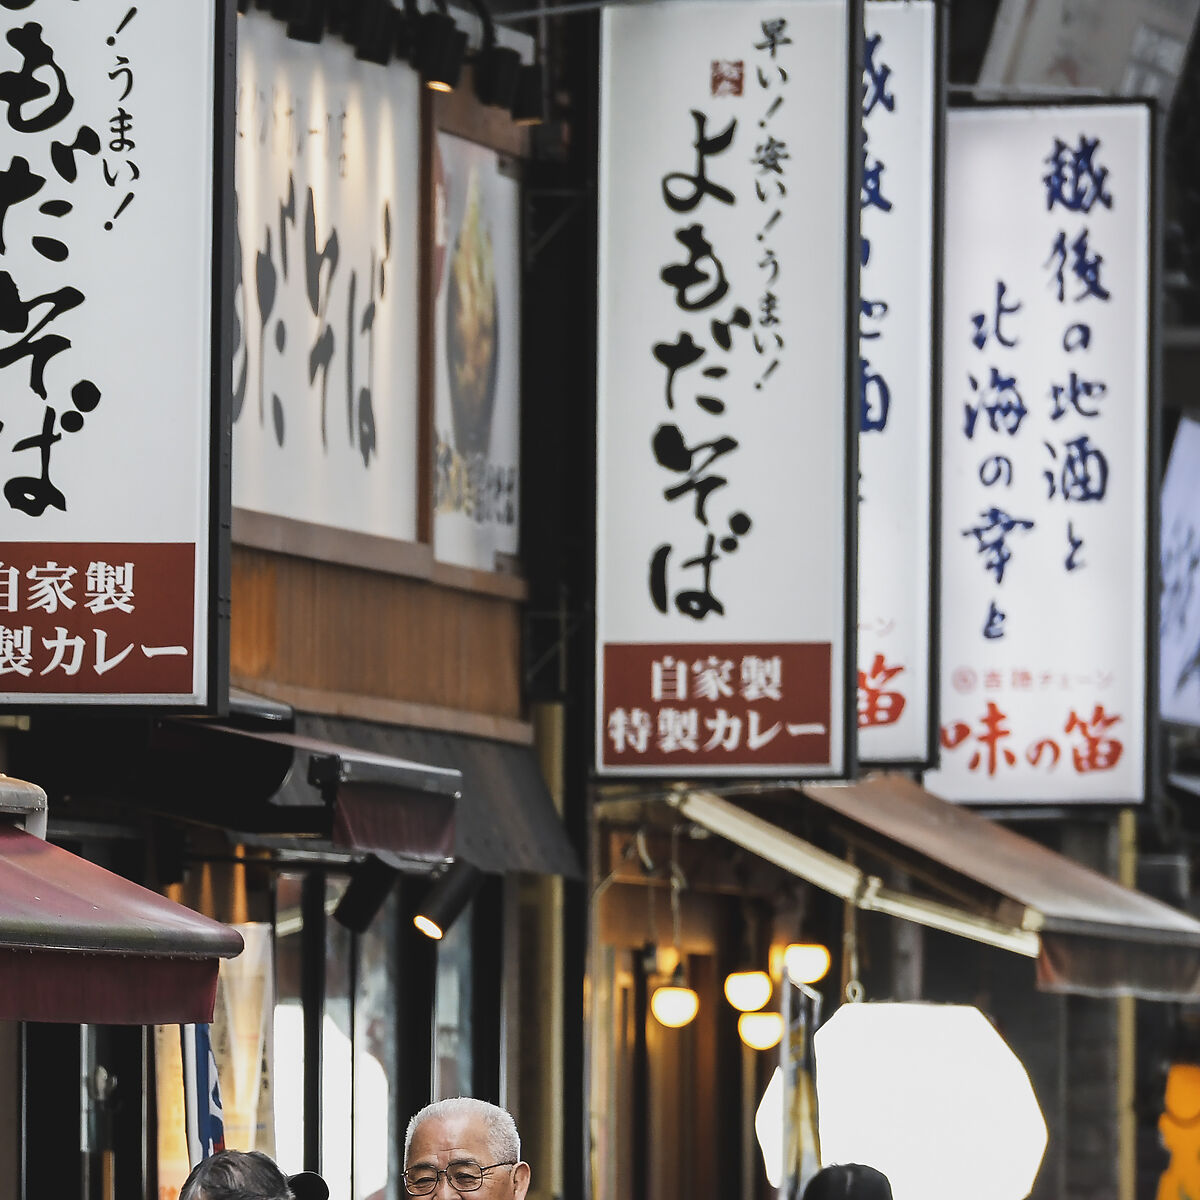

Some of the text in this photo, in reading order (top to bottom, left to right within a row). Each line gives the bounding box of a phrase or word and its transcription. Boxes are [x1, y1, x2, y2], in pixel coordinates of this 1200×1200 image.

[649, 110, 752, 620] よもだそば
[961, 280, 1034, 640] 北海の幸と
[1043, 135, 1115, 572] 越後の地酒と
[607, 707, 826, 754] 特製カレー
[651, 655, 783, 702] 自家製
[939, 701, 1125, 780] 味の笛
